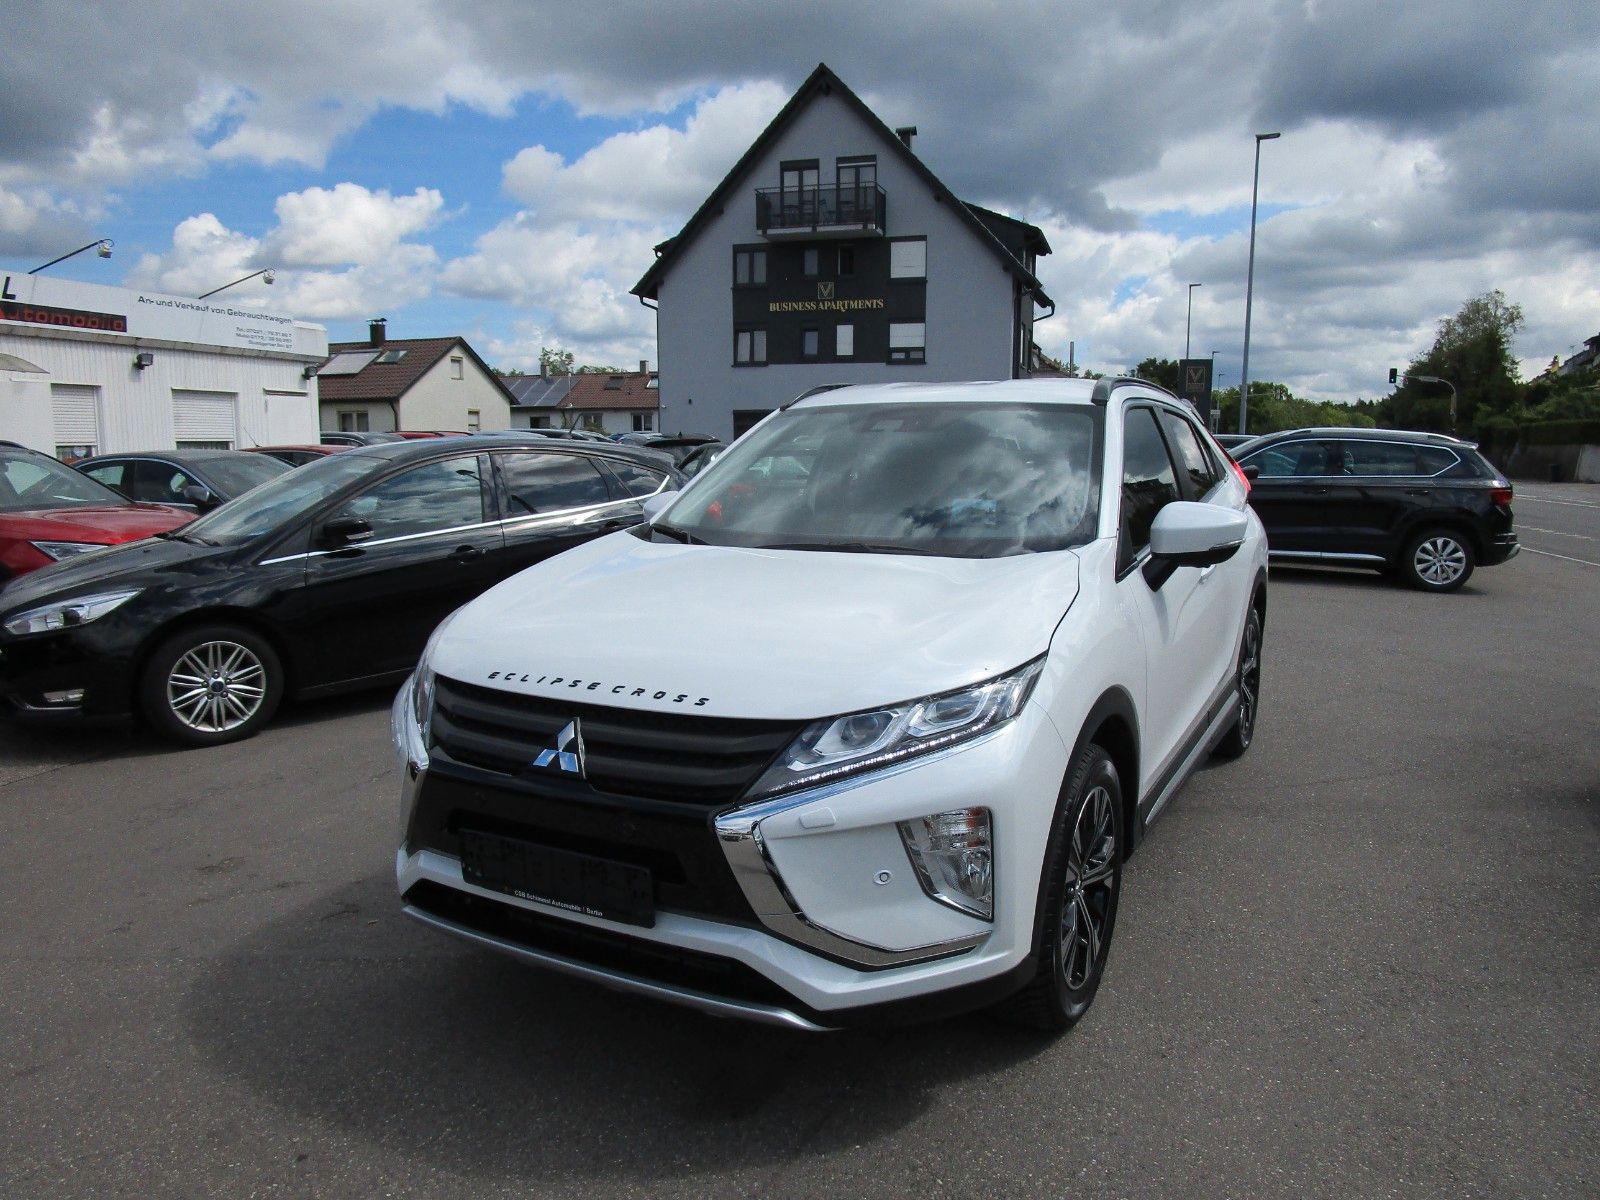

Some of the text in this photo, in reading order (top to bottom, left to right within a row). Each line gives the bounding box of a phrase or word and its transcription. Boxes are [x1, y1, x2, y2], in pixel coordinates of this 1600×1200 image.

[138, 296, 292, 325] An- und Verkauf von Gebrauchtwagen
[769, 299, 884, 312] BUSINESS APARTMENTS
[488, 671, 710, 707] ECLIPSE CROSS
[586, 907, 603, 917] Berlin
